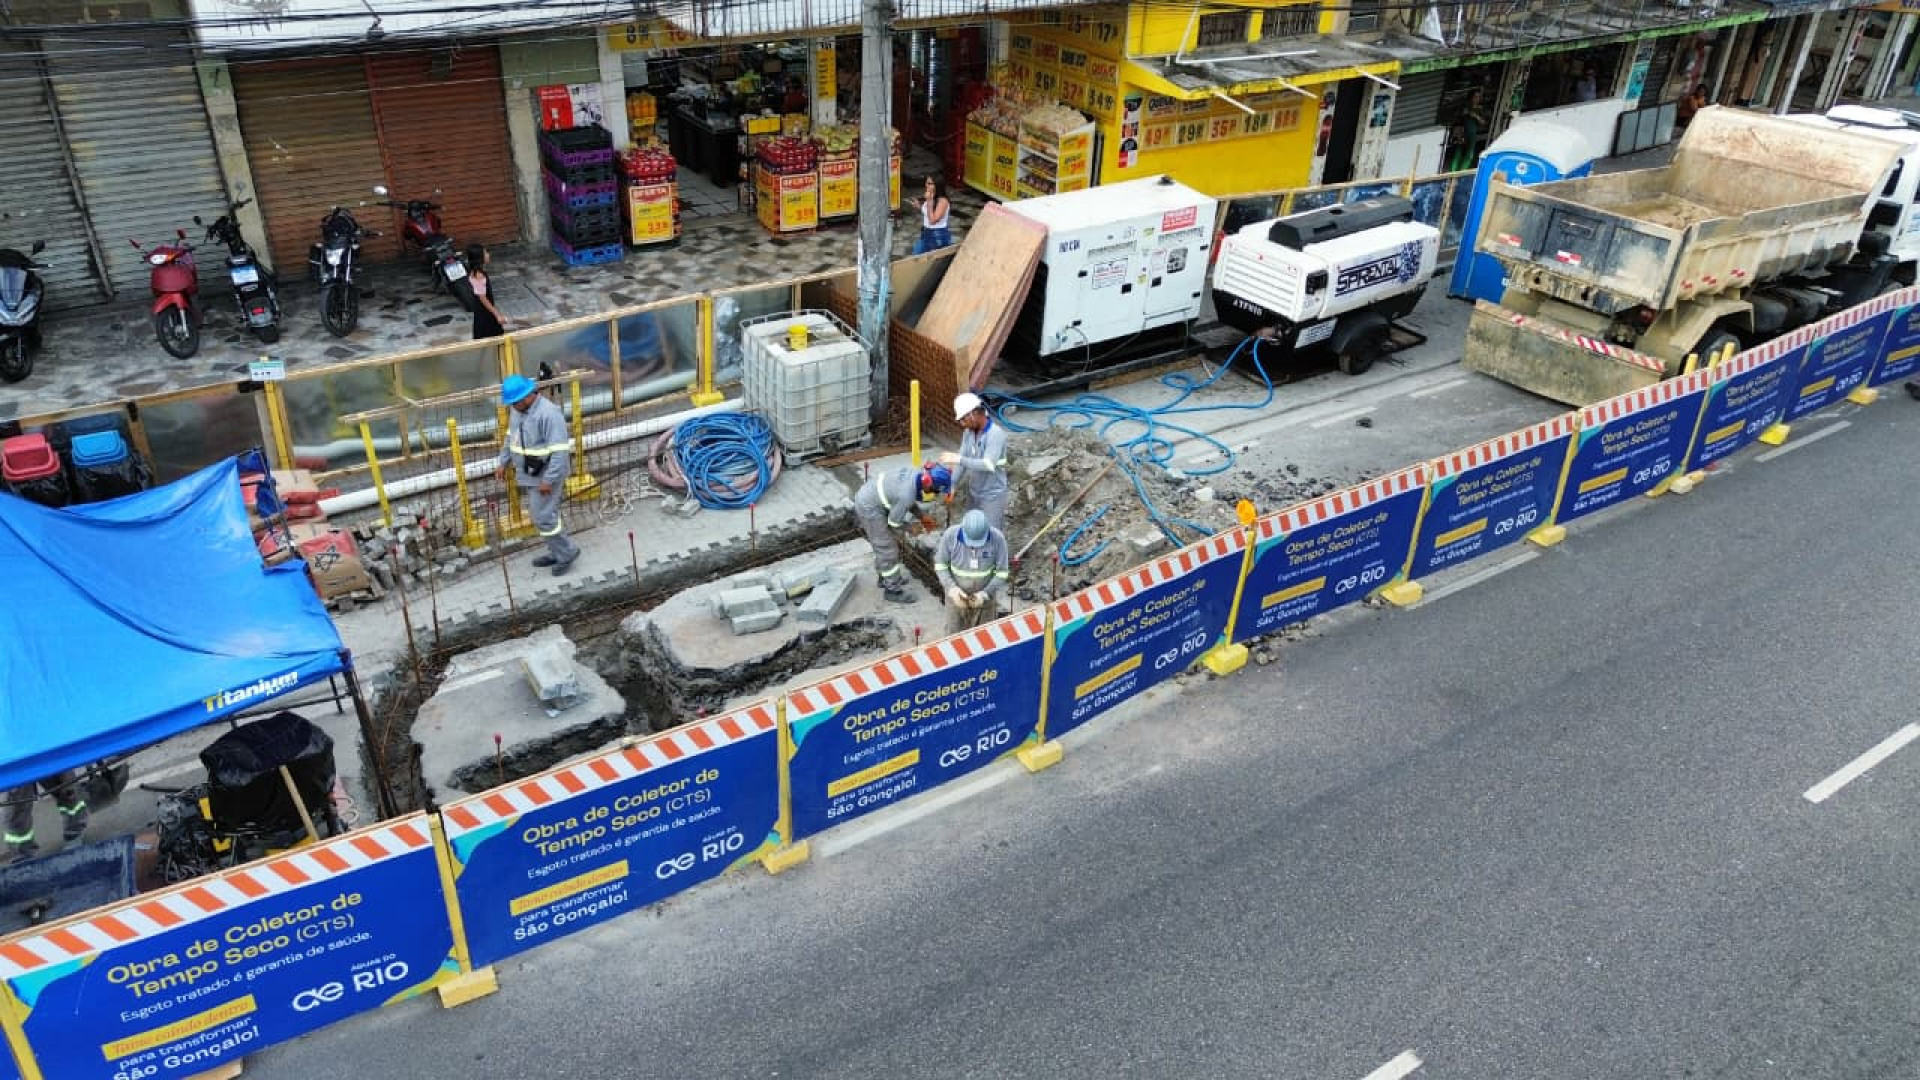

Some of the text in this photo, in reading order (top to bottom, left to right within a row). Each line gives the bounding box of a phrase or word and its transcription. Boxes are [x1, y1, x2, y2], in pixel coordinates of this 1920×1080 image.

[1359, 566, 1385, 584] RIO
[1180, 634, 1205, 655] RIO
[843, 669, 997, 730] Obra de Coletor de
[851, 686, 989, 743] Tempo Seco (CTS)
[976, 730, 1010, 753] RIO
[523, 769, 718, 842] Obra de Coletor de
[535, 788, 710, 856] Tempo Seco (CTS)
[827, 774, 916, 818] São Gonçalo!
[702, 834, 744, 861] RIO
[107, 893, 361, 983] Obra de Coletor de
[513, 888, 626, 940] São Gonçalo!
[119, 1000, 173, 1021] Esgoto
[176, 979, 230, 1003] tratado
[245, 953, 303, 980] garantia
[305, 946, 324, 956] de
[327, 932, 372, 950] saúde.
[125, 913, 354, 997] Tempo Seco (CTS)
[353, 961, 408, 991] RIO
[119, 1016, 254, 1071] para transformar
[163, 1025, 258, 1068] Gonçalo!
